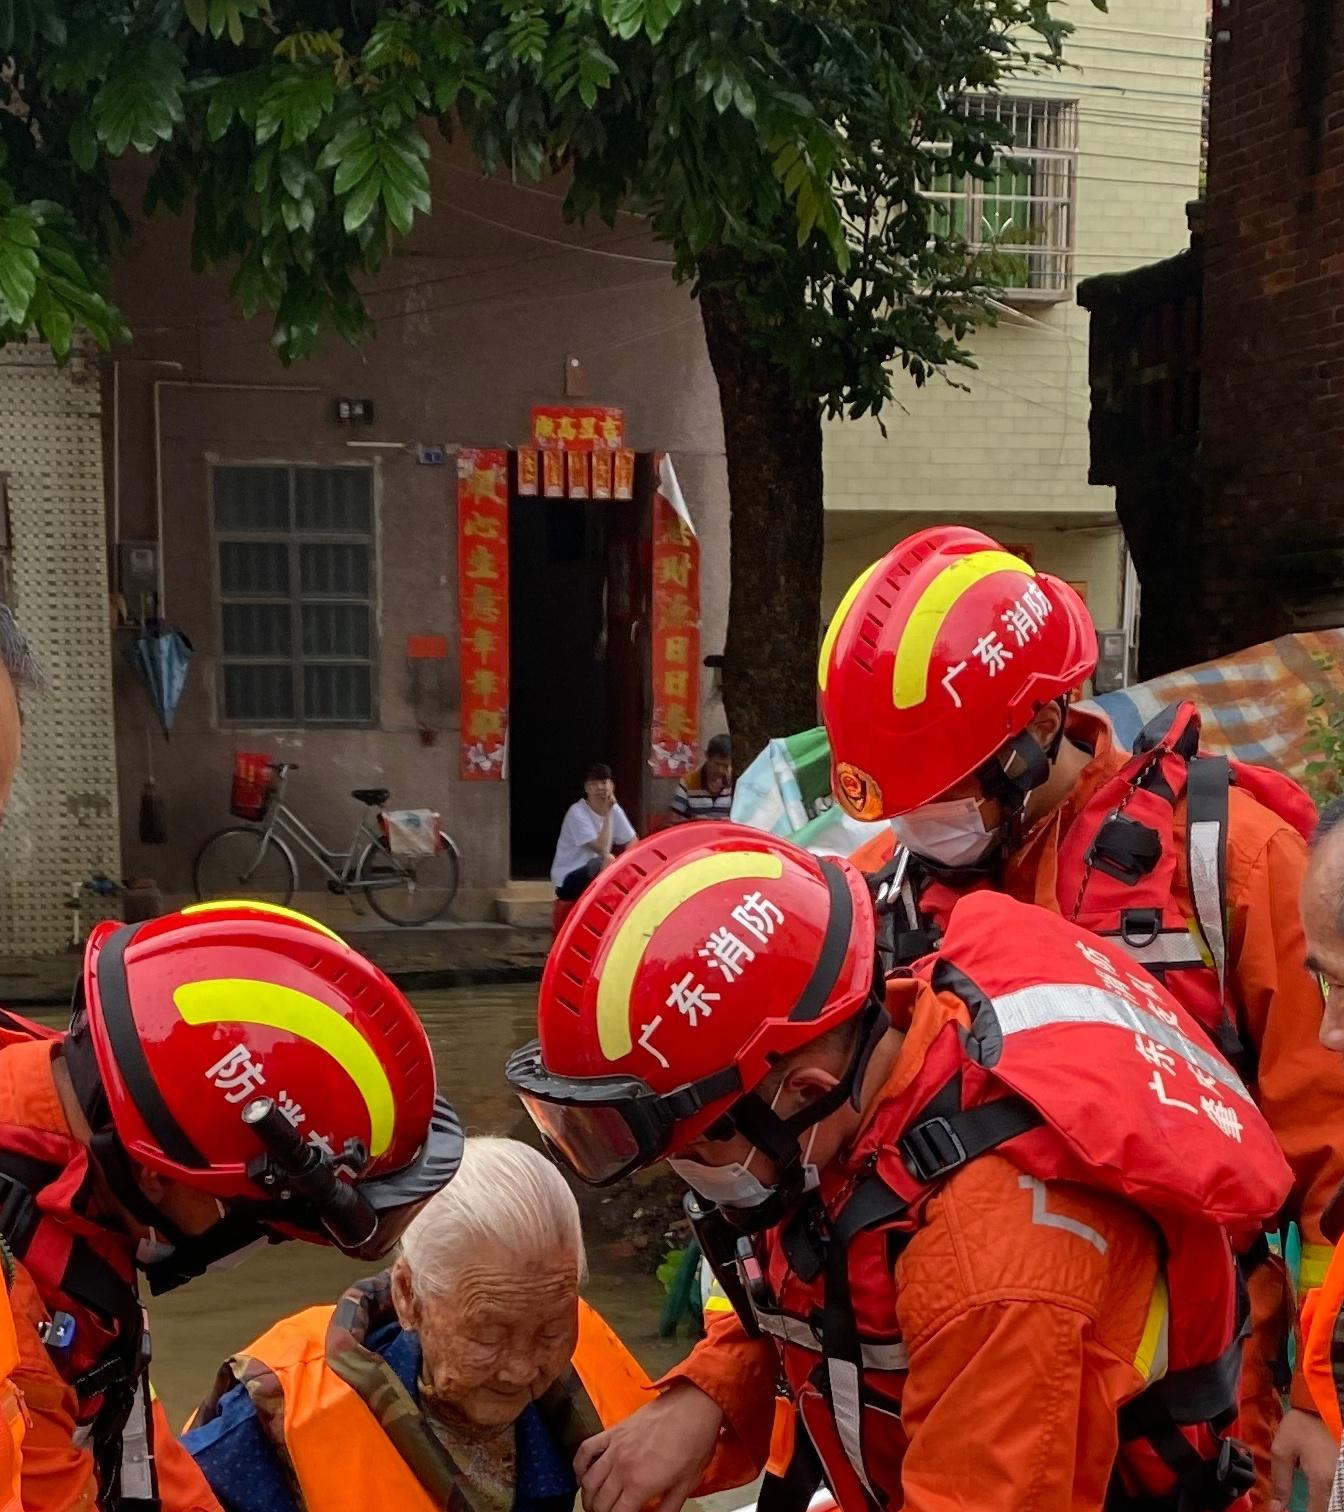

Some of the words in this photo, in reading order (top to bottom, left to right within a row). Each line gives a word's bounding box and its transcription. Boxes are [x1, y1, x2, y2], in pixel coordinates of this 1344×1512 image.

[941, 582, 1053, 708] 广东消防
[637, 891, 785, 1068] 广东消防
